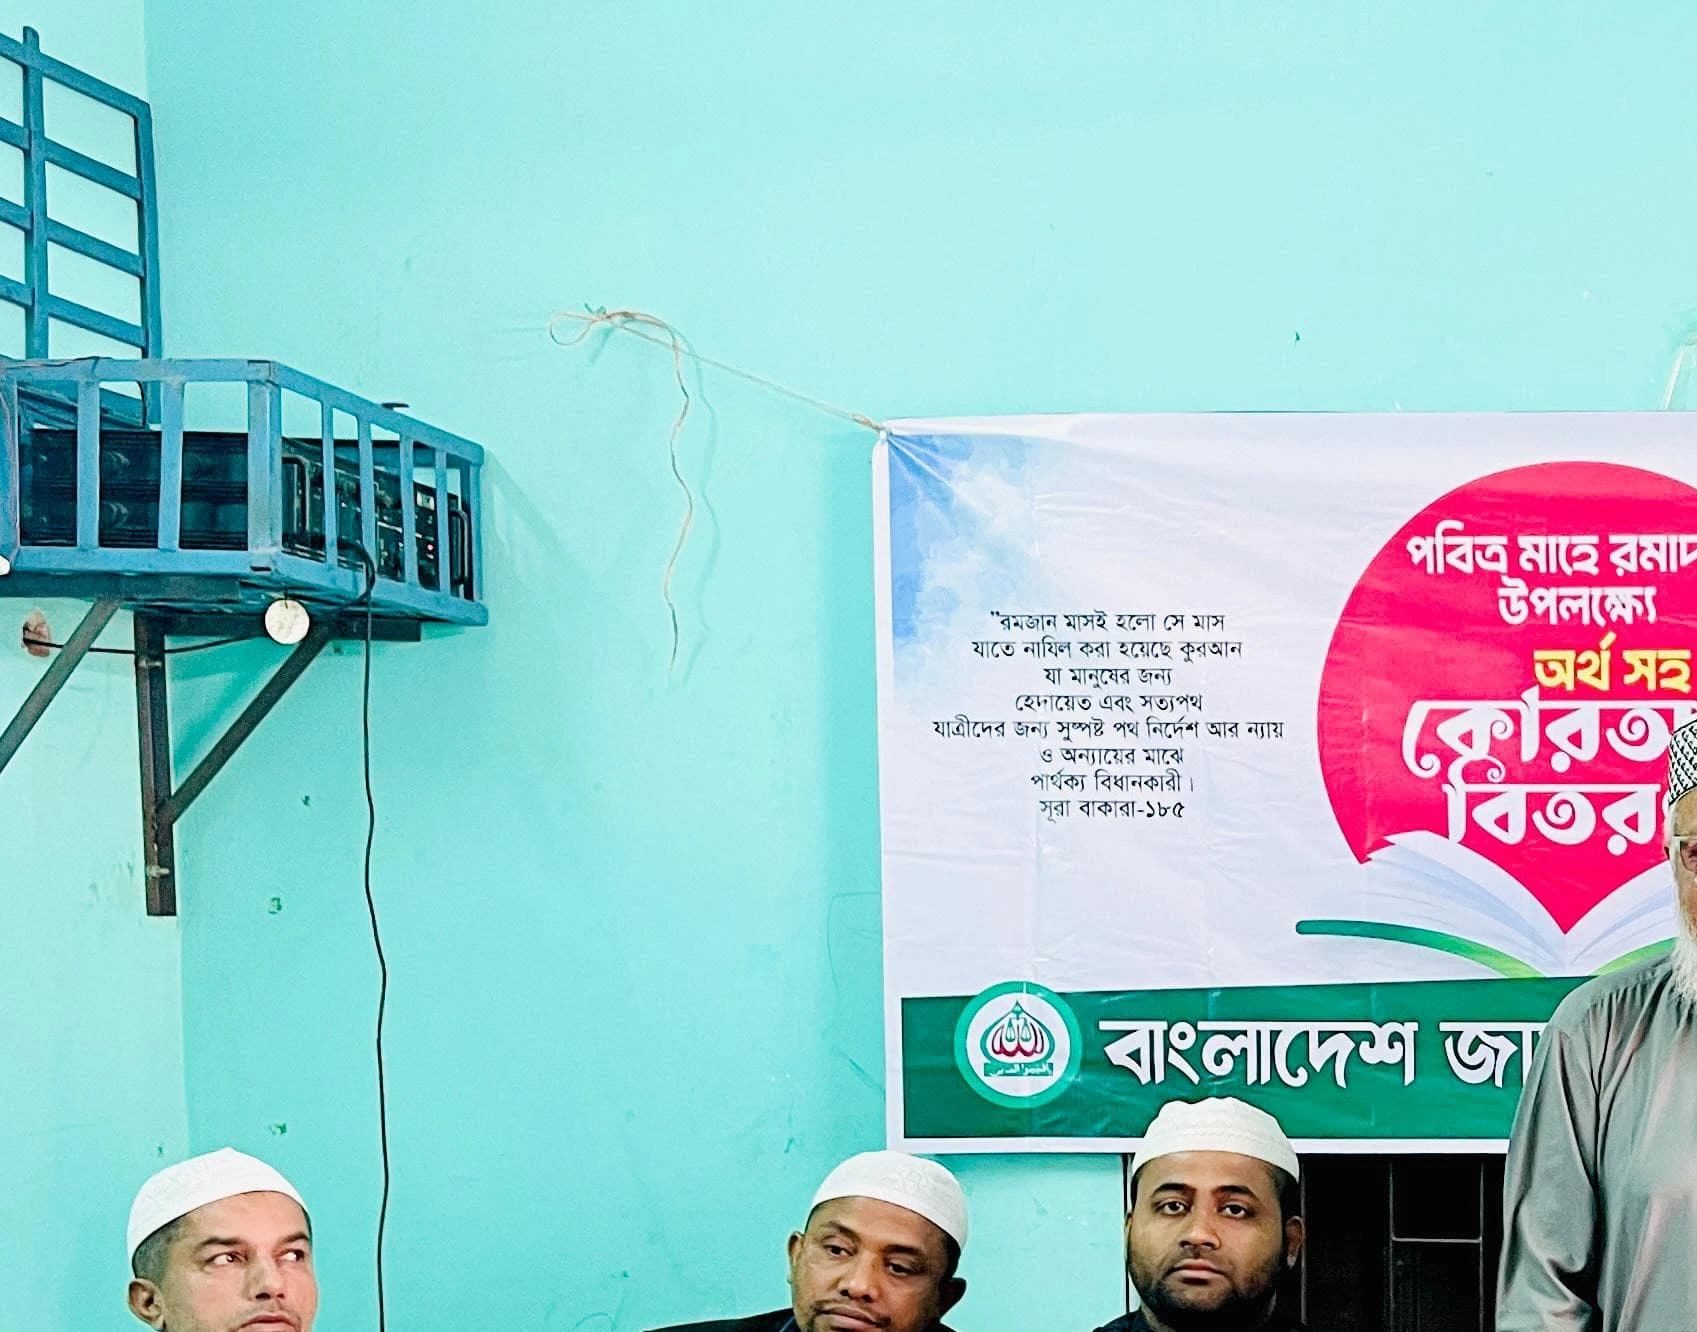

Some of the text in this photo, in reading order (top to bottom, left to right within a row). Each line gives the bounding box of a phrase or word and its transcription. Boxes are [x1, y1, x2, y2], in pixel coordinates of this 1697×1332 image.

[1405, 519, 1509, 576] পবিত্র
[1517, 535, 1599, 575] মাহে
[1063, 609, 1108, 631] মাসই
[1115, 613, 1157, 631] হলো
[1163, 614, 1185, 631] সে
[1191, 614, 1225, 631] মাস
[971, 634, 1242, 663] যাতে নাযিল করা হয়েছে কুরআন
[1532, 631, 1691, 693] অর্থ সহ
[1042, 668, 1173, 689] যা মানুষের জন্য
[1015, 694, 1203, 713] হেদায়েত এবং সত্যপথ
[932, 713, 1005, 738] যাত্রীদের
[1014, 721, 1048, 738] জন্য
[1112, 721, 1140, 738] পথ
[1145, 715, 1200, 739] নির্দেশ
[1207, 721, 1240, 738] আর
[1246, 721, 1285, 739] ন্যায়
[1040, 747, 1184, 765] ও অন্যায়ের মাঝে
[1030, 769, 1087, 791] পার্থক্য
[1093, 767, 1181, 792] বিধানকারী
[1039, 800, 1071, 822] সূরা
[1442, 756, 1669, 856] বিতর
[1098, 1020, 1419, 1088] বাংলাদেশ
